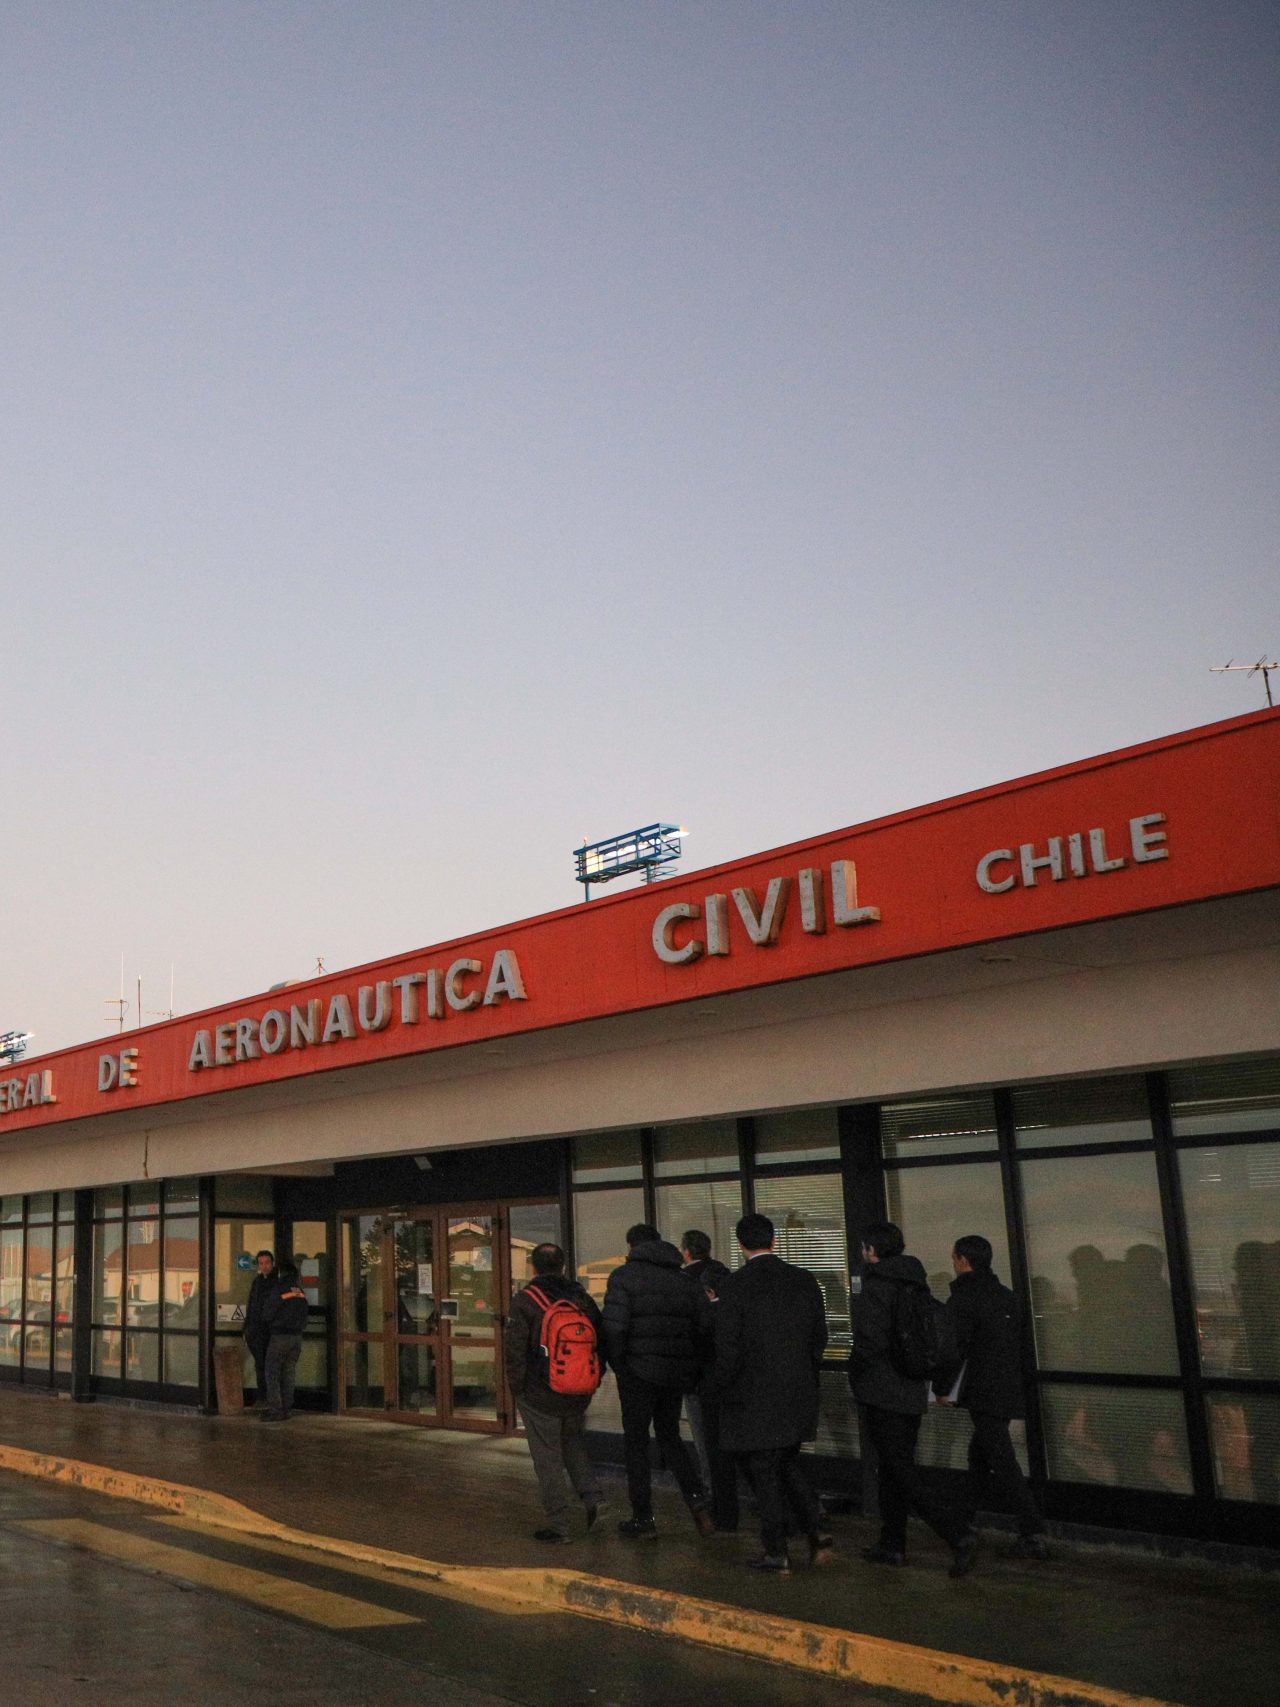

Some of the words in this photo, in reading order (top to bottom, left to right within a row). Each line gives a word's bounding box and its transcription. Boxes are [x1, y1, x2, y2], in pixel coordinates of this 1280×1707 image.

[98, 1048, 139, 1092] DE
[188, 949, 528, 1073] AERONAUTICA
[652, 860, 880, 965] CIVIL
[976, 812, 1169, 894] CHILE
